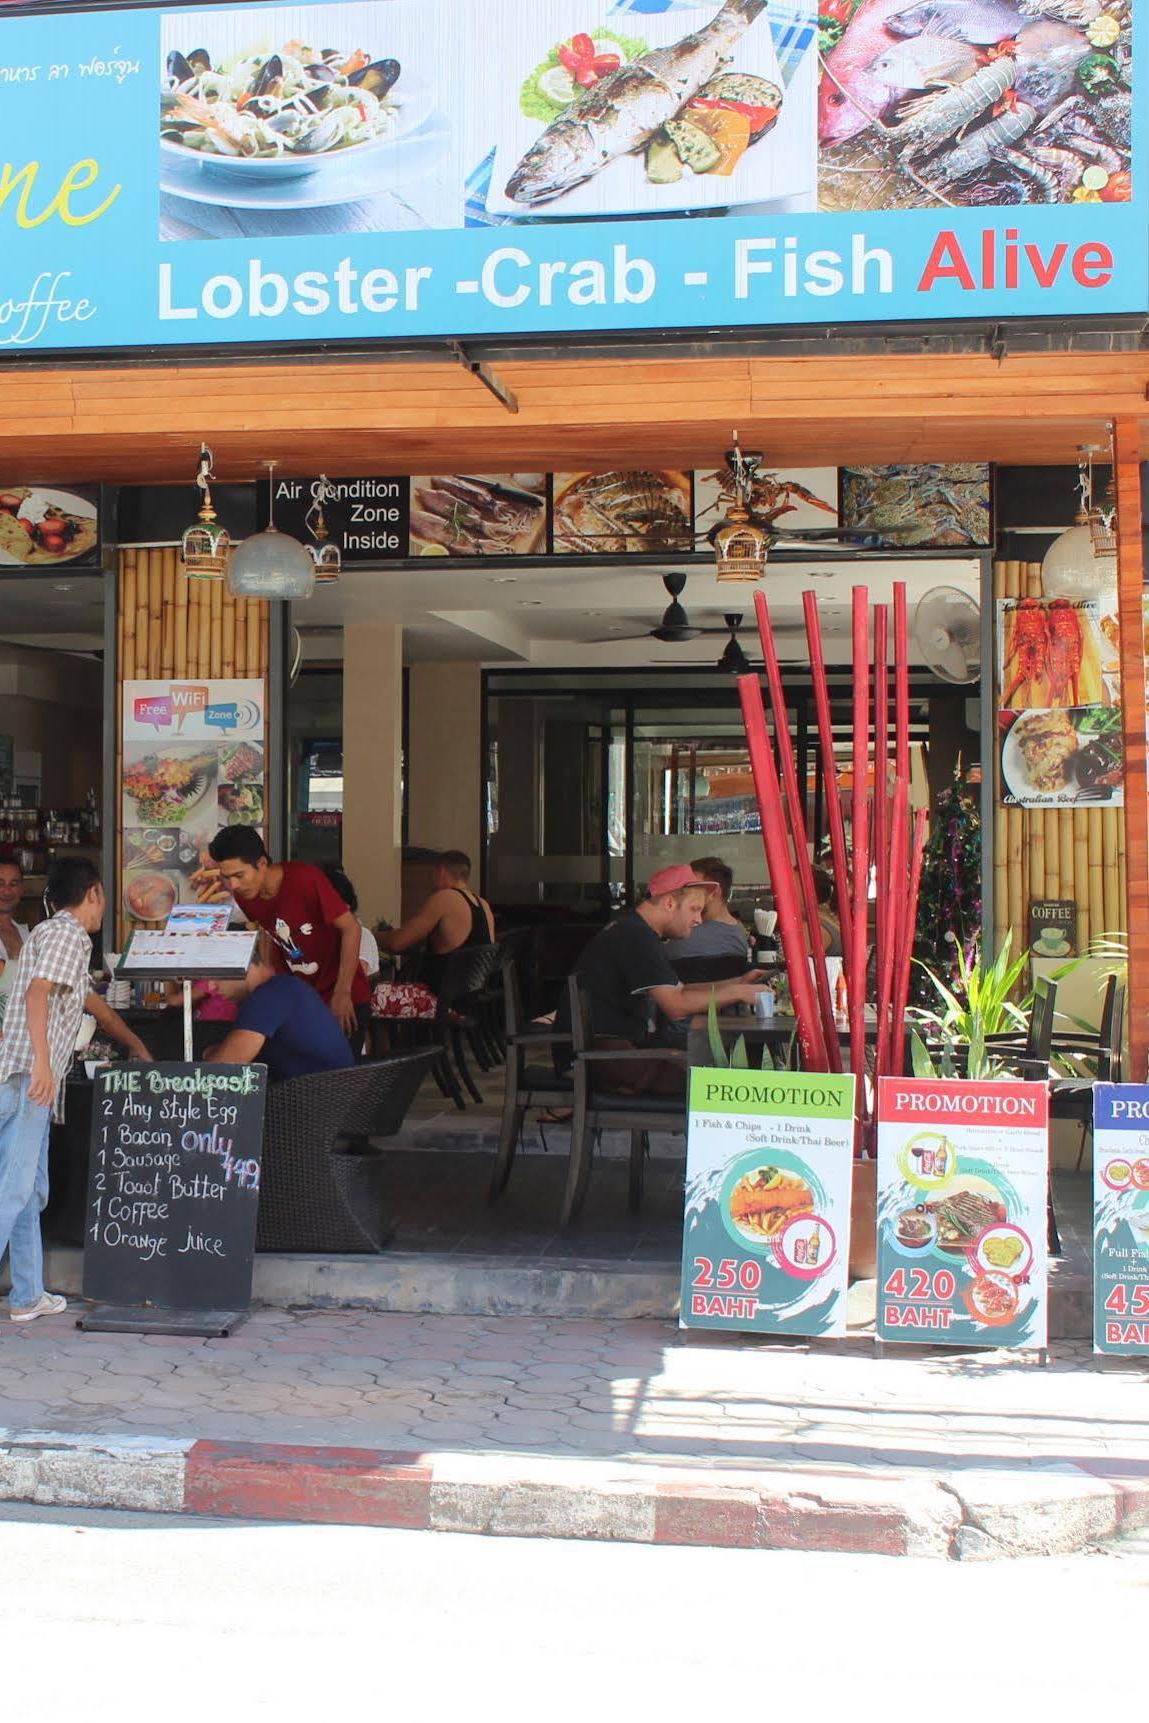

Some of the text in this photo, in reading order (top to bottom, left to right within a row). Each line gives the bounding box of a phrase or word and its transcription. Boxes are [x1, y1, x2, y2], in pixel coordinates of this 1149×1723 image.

[159, 257, 433, 320] Lobster
[735, 233, 893, 298] Fish
[919, 229, 1113, 291] Alive
[275, 480, 399, 499] Air Condition
[351, 504, 400, 522] Zone
[343, 531, 399, 549] Inside
[139, 704, 167, 716] Free
[171, 691, 206, 707] WiFi
[209, 710, 232, 719] Zone
[1031, 906, 1071, 919] COFFEE
[100, 1066, 259, 1098] THE Breakfast
[705, 1083, 844, 1107] PROMOTION
[894, 1093, 1037, 1115] PROMOTION
[101, 1094, 238, 1128] 2 Any Style Egg
[101, 1126, 108, 1143] 1
[117, 1123, 173, 1147] Bacon
[694, 1119, 699, 1128] 1
[702, 1119, 723, 1129] Fish
[724, 1120, 733, 1129] &
[735, 1120, 762, 1131] Chips
[784, 1122, 811, 1133] Drink
[97, 1147, 181, 1173] 1 Sausage
[94, 1173, 107, 1190] 2
[168, 1174, 228, 1201] Butter
[92, 1196, 170, 1226] 1 Coffee
[89, 1220, 99, 1242] 1
[103, 1221, 169, 1261] Orange
[1109, 1247, 1129, 1257] Full
[691, 1256, 762, 1291] 250
[884, 1267, 956, 1300] 420
[691, 1294, 759, 1319] BAHT
[884, 1305, 954, 1329] BAHT
